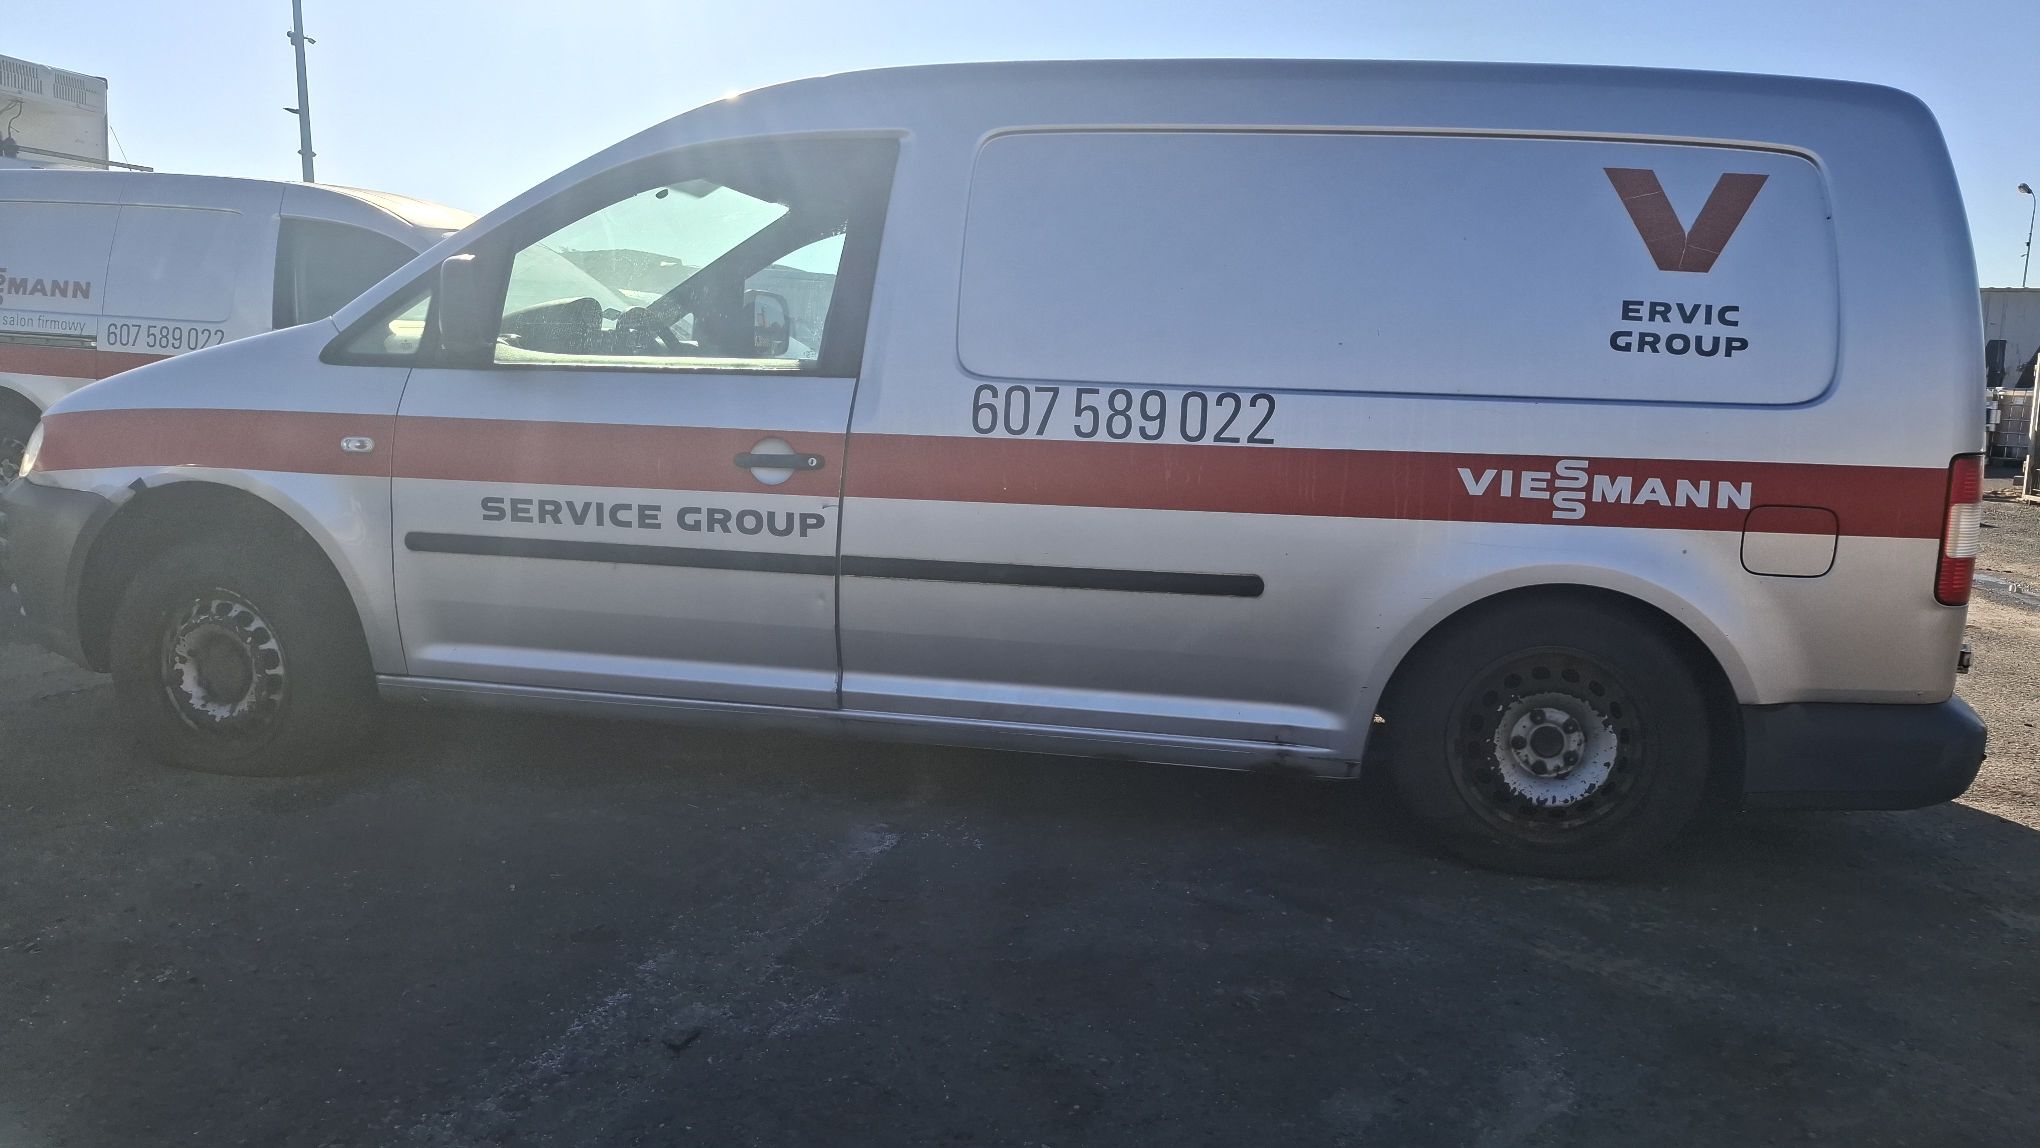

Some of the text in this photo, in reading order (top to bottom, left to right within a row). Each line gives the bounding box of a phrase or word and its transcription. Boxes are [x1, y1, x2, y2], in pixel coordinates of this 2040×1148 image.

[2, 313, 86, 335] salon firmowy
[1621, 300, 1740, 327] ERVIC
[107, 323, 141, 346] 607
[147, 325, 183, 349] 589
[1609, 330, 1749, 358] GROUP
[972, 384, 1276, 445] 607 589 022
[1457, 459, 1752, 520] VIESSMANN
[480, 496, 826, 538] SERVICE GROUP
